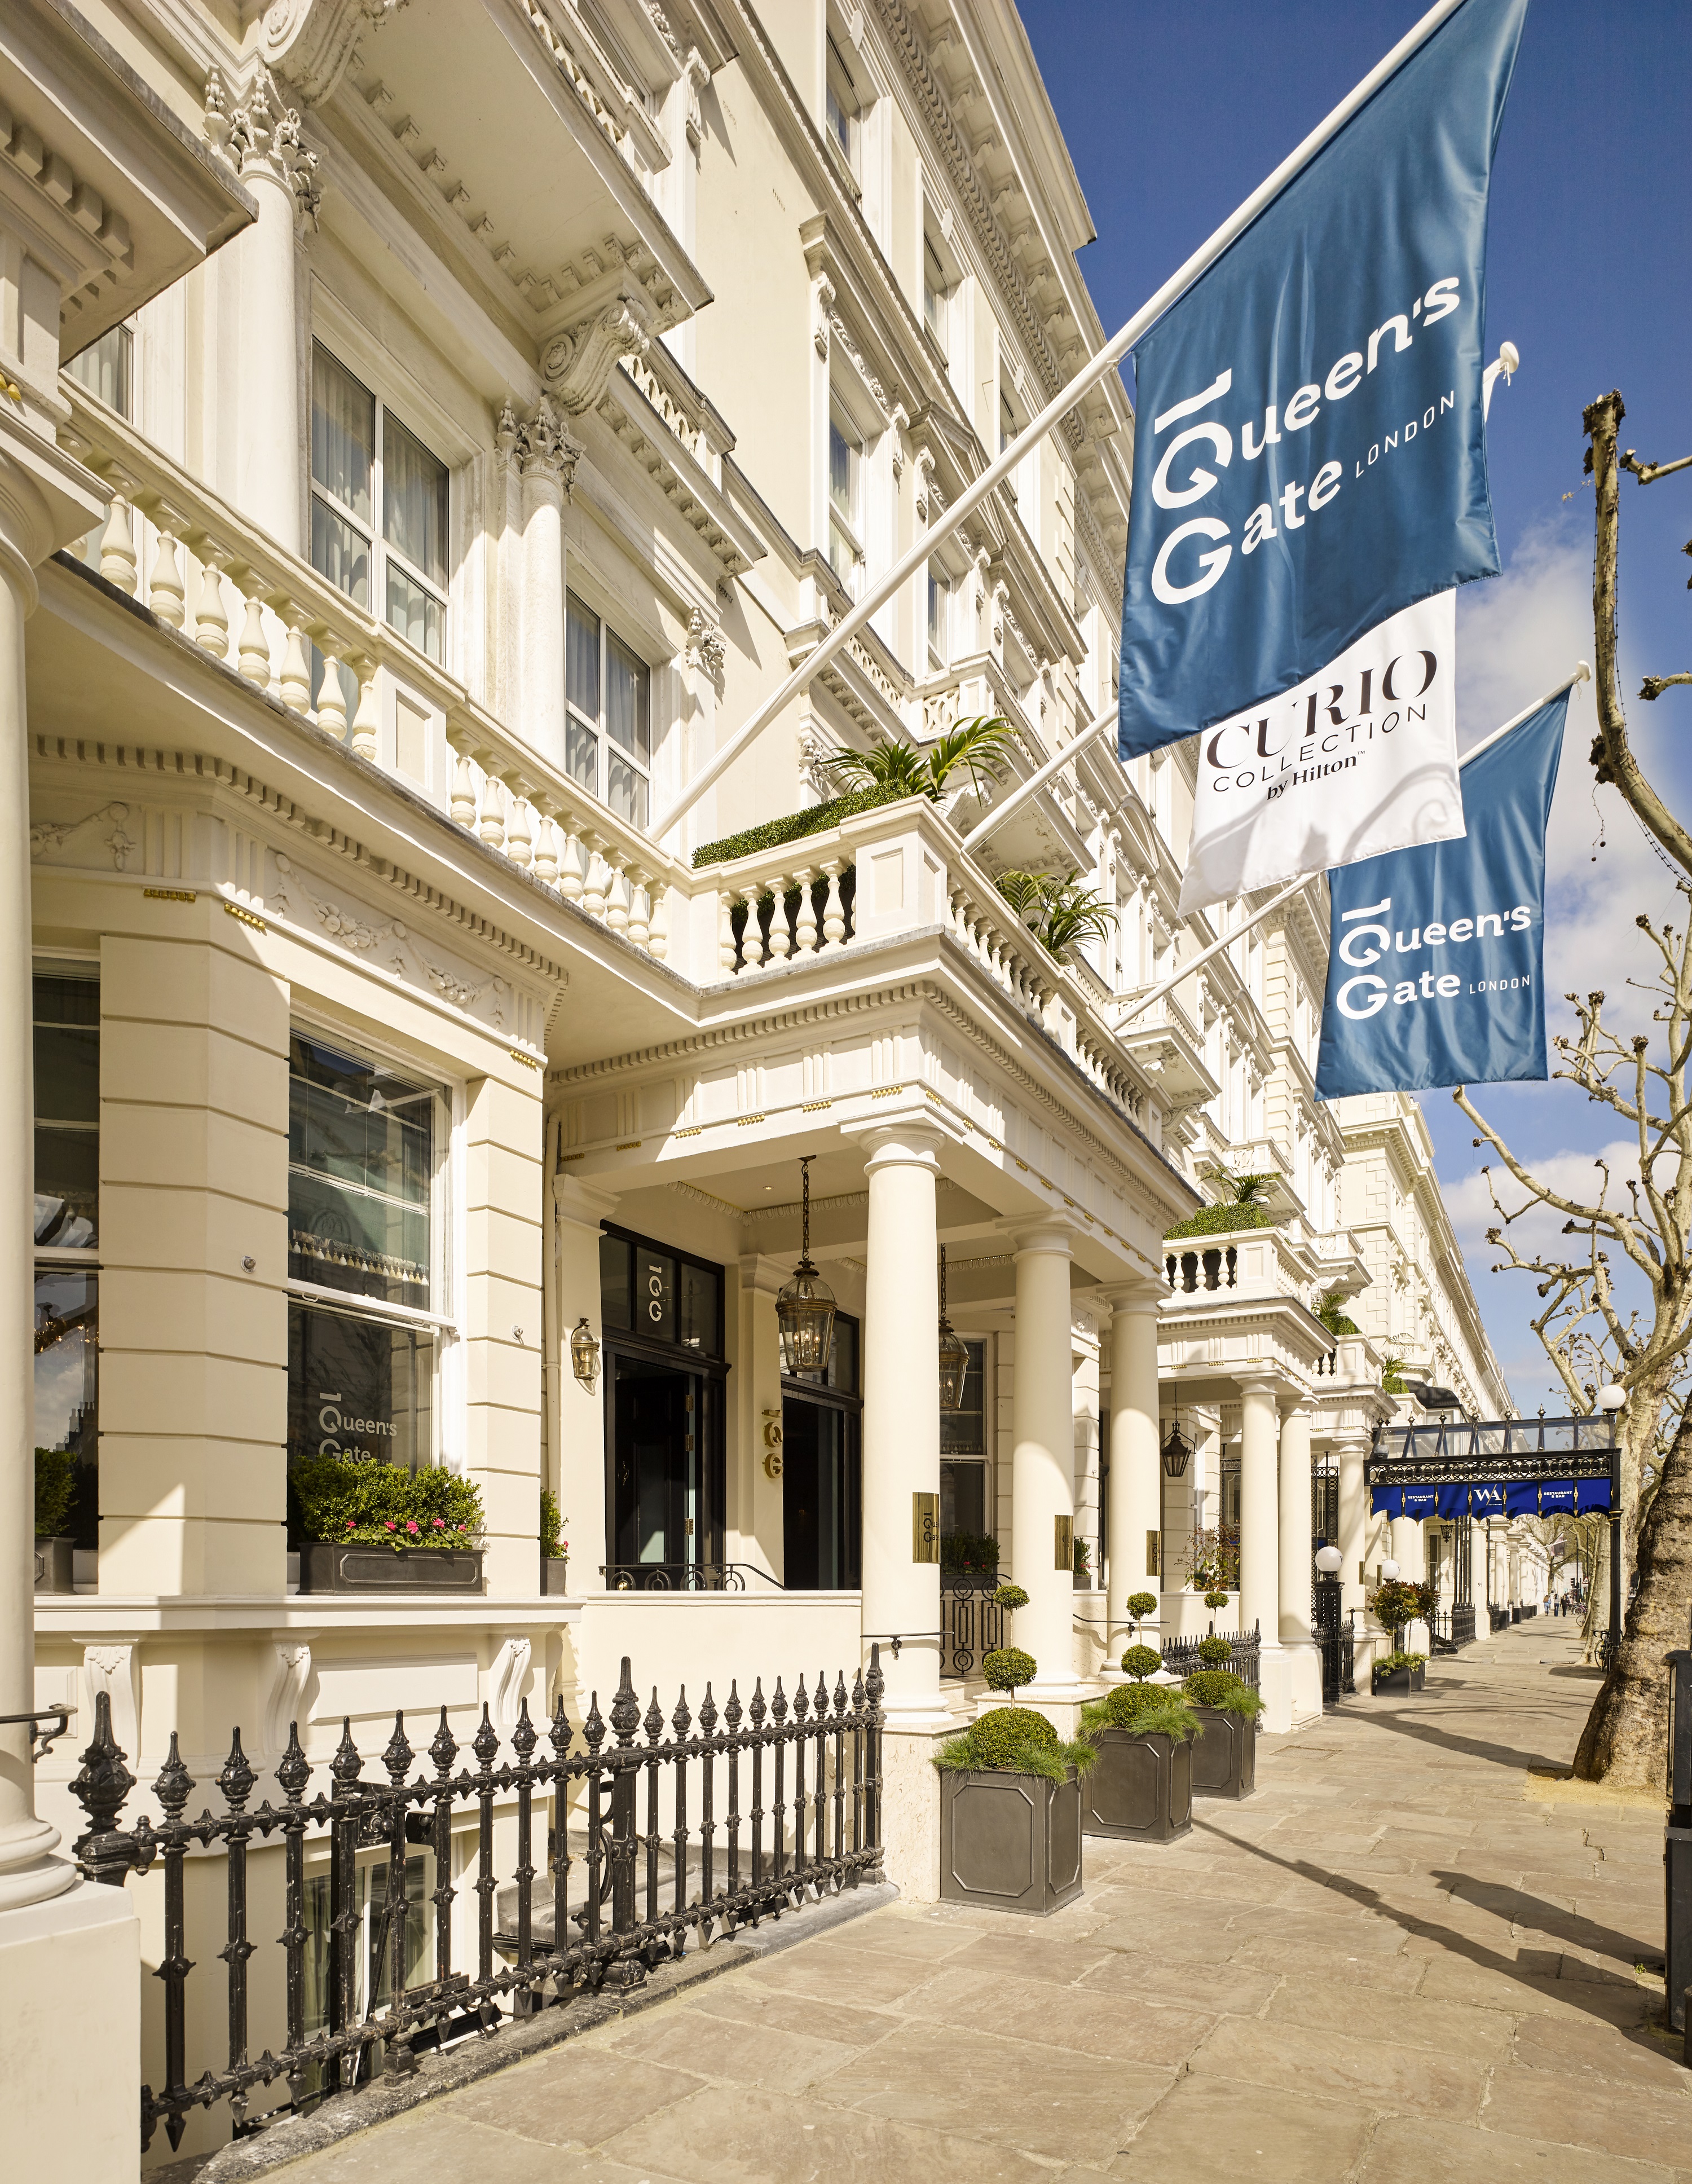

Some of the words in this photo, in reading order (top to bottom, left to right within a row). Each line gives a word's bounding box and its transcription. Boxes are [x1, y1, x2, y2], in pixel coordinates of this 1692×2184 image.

[1152, 277, 1460, 509] Queen's
[1151, 461, 1342, 605] Gate
[1356, 390, 1454, 478] LONDON
[1206, 650, 1437, 769] CURIO
[1213, 703, 1426, 792] COLLECTION
[1266, 780, 1288, 800] by
[1338, 906, 1531, 967] Queen's
[1336, 971, 1460, 1020] Gate
[1469, 975, 1530, 994] LONDON
[319, 1406, 397, 1437] Queen's
[319, 1438, 371, 1464] Gate
